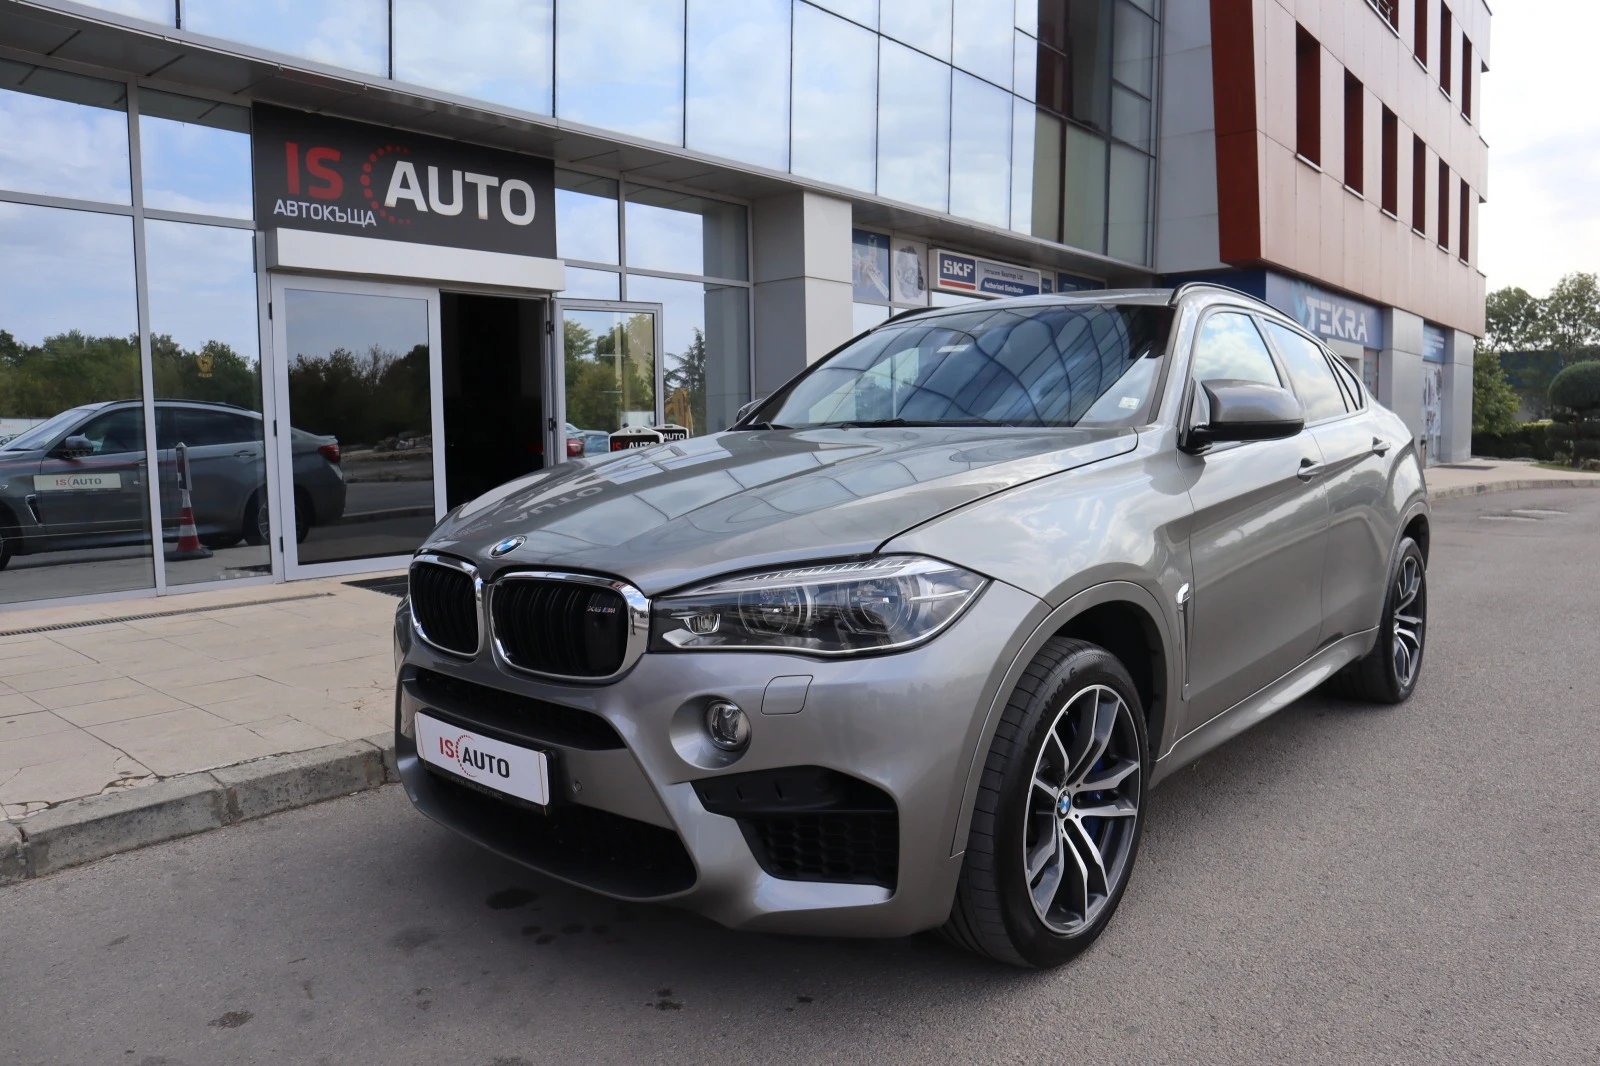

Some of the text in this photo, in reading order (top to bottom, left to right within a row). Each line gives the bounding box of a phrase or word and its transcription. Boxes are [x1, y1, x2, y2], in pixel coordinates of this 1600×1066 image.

[284, 141, 536, 226] IS AUTO
[273, 198, 377, 228] АВТОКЪЩА
[943, 260, 973, 277] SKF
[663, 432, 685, 440] AUTO
[72, 478, 102, 486] AUTO
[439, 736, 510, 779] IS AUTO
